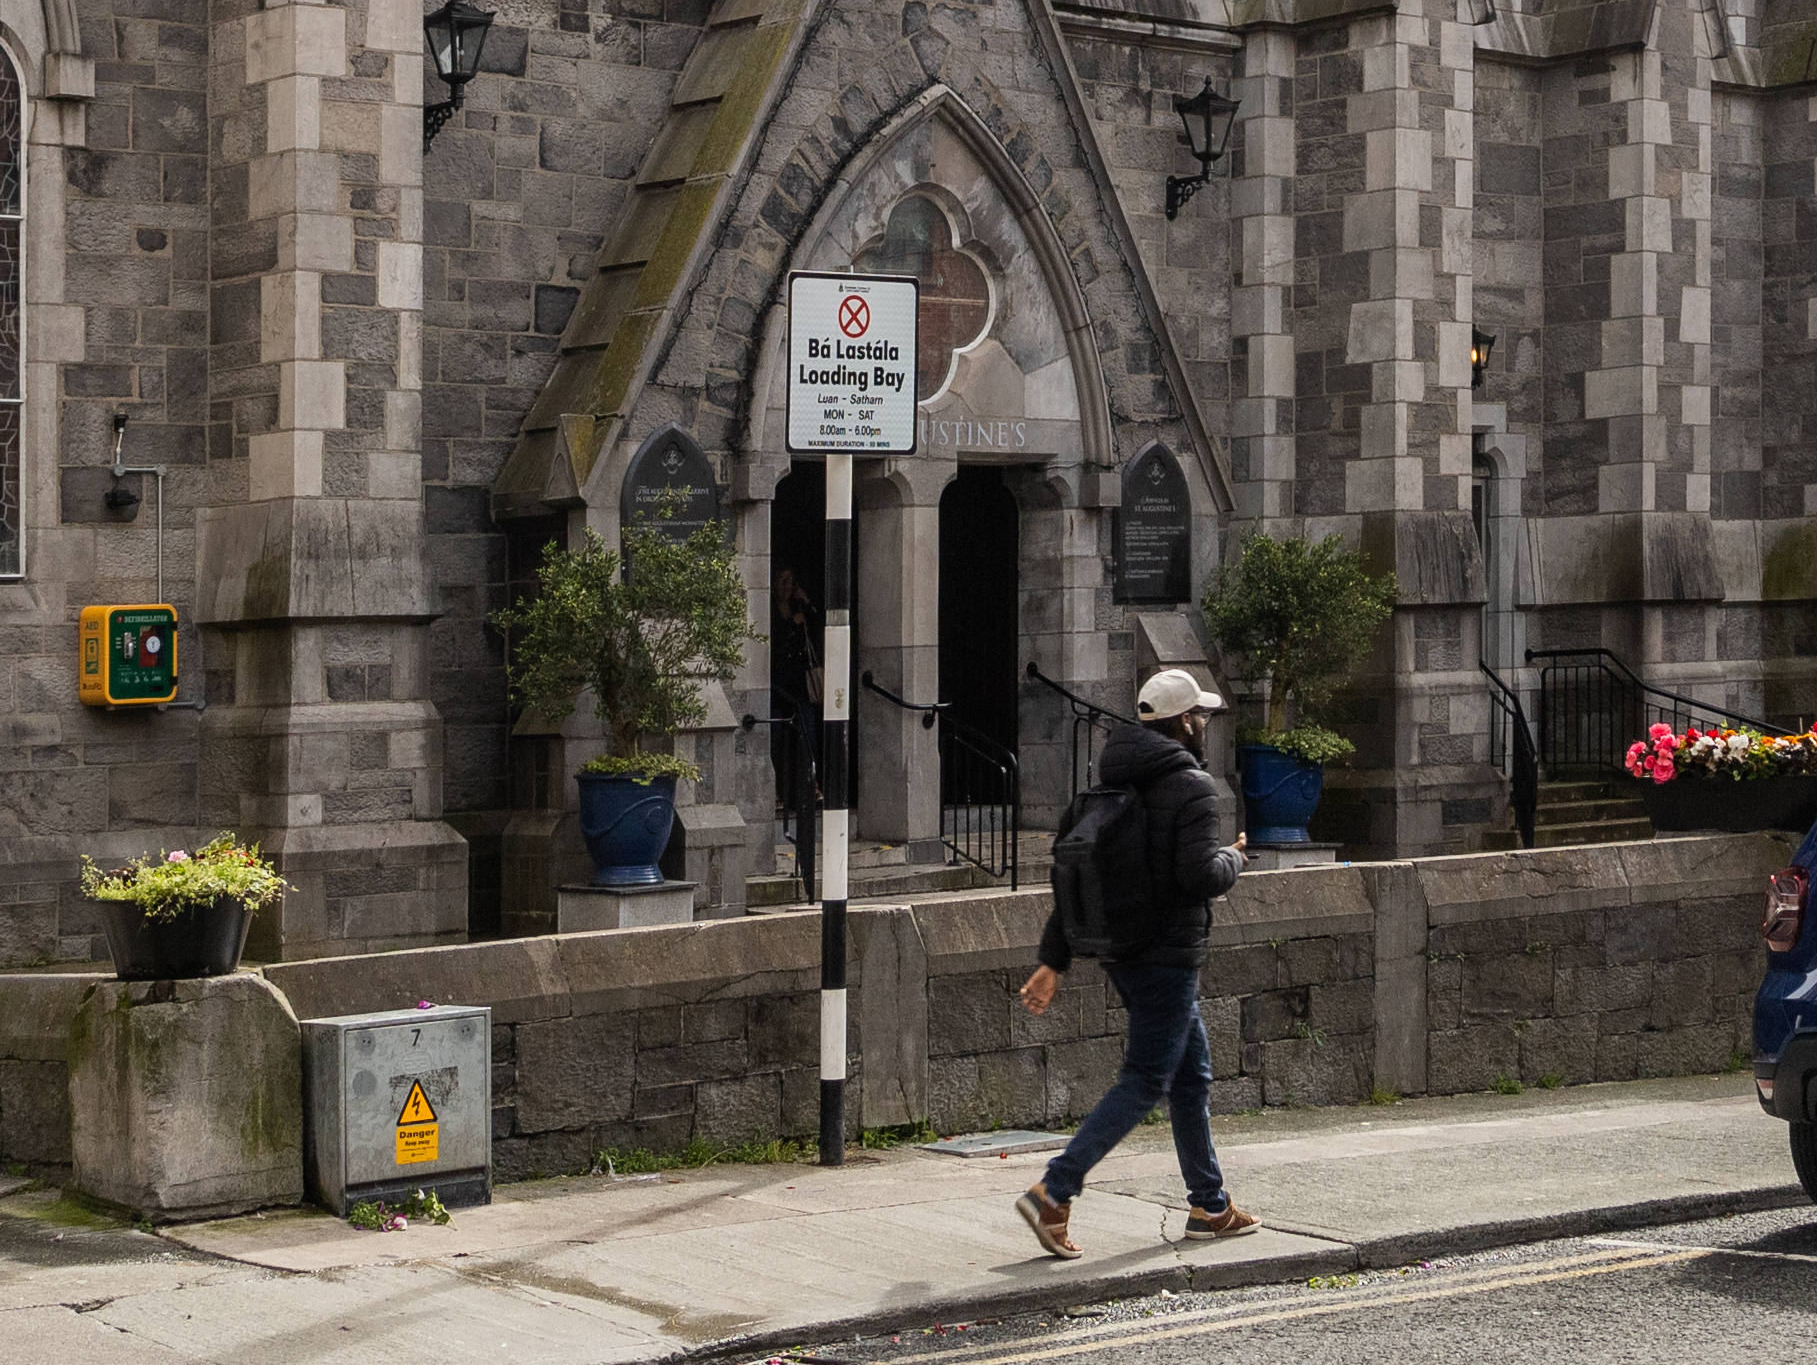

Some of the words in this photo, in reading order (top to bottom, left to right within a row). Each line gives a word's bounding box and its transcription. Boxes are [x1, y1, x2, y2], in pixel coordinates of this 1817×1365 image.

[808, 336, 832, 360] Bá
[835, 338, 900, 362] Lastála
[799, 363, 869, 392] Loading
[873, 366, 906, 393] Bay
[817, 392, 839, 405] Luan
[849, 393, 884, 406] Satharn
[823, 409, 845, 421] MON
[858, 410, 875, 421] SAT
[819, 424, 847, 436] 8.00am
[854, 425, 882, 438] 6.00pm
[919, 419, 1026, 448] USTINE'S
[836, 440, 865, 448] DURATION
[85, 620, 99, 630] AED
[410, 1028, 422, 1047] 7
[399, 1128, 436, 1140] Danger
[405, 1140, 417, 1148] Keep
